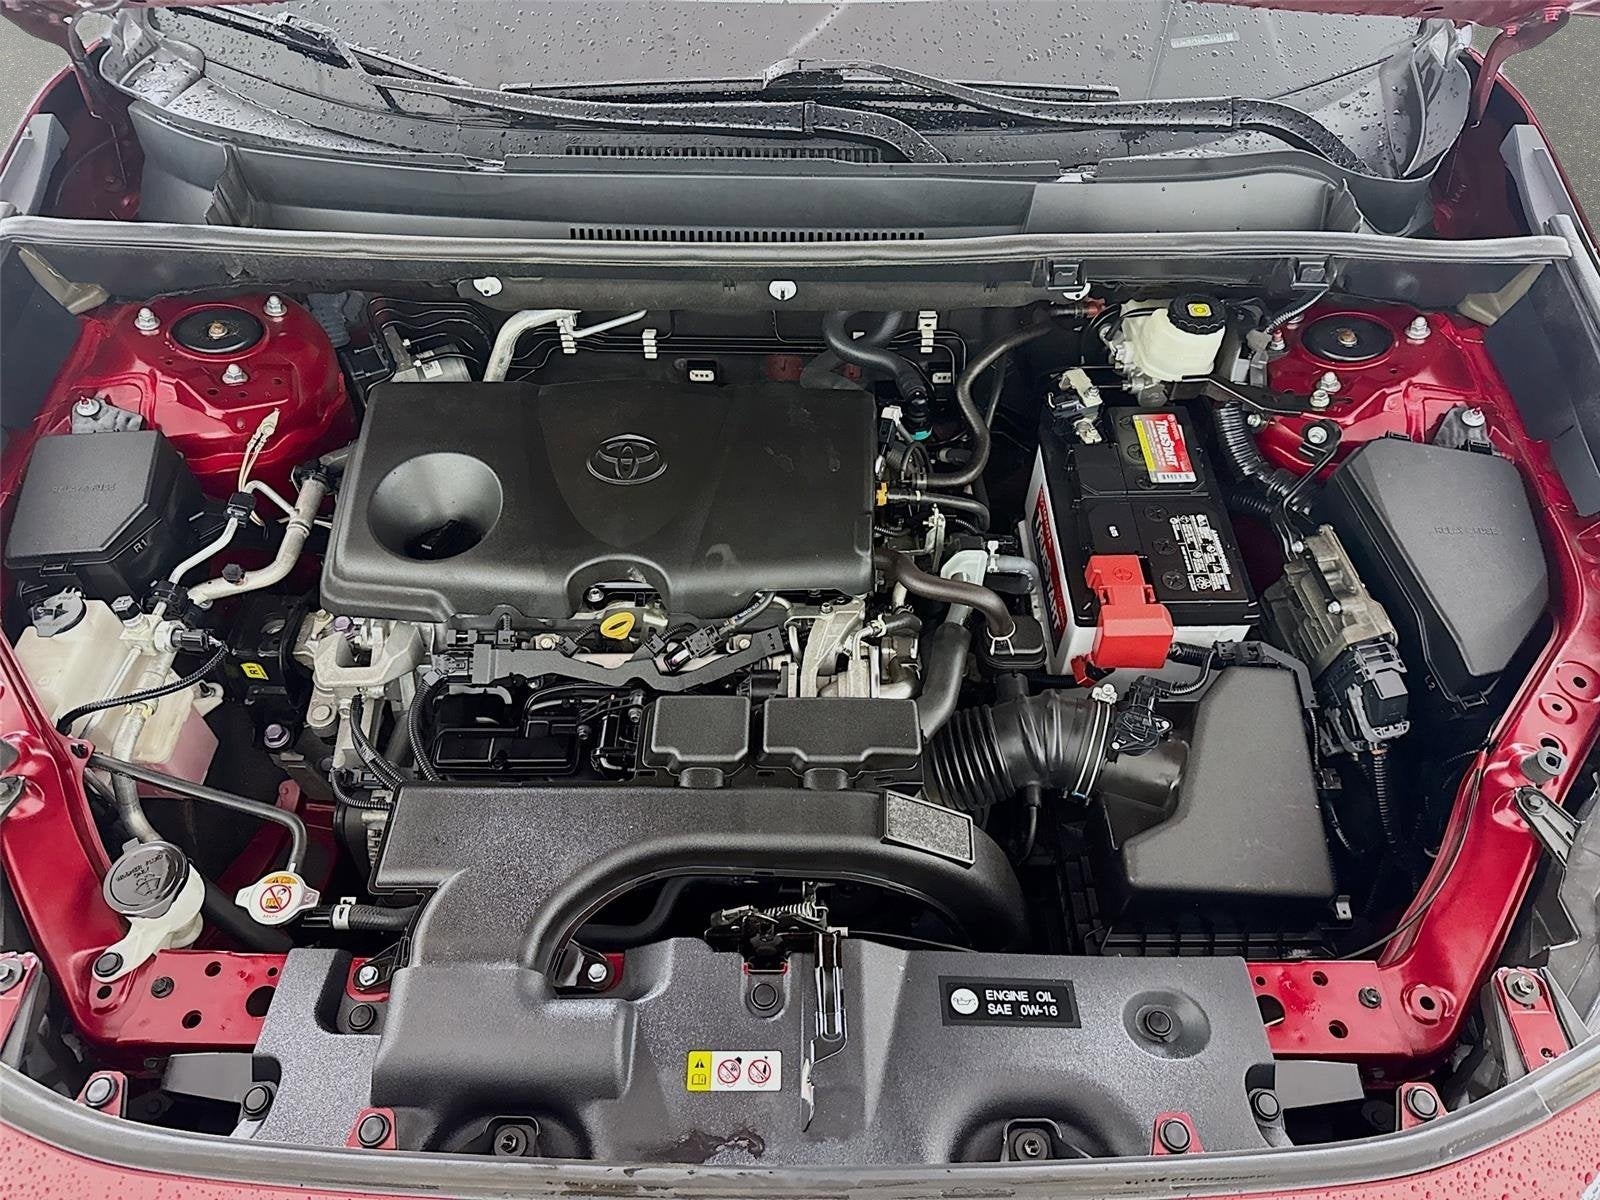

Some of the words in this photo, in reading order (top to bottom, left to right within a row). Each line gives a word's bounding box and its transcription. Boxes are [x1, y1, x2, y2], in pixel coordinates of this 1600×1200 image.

[133, 539, 148, 553] R1
[985, 989, 1029, 1002] ENGINE
[1036, 991, 1057, 1003] OIL
[987, 1003, 1013, 1015] SAE
[1020, 1004, 1058, 1016] 0W-16
